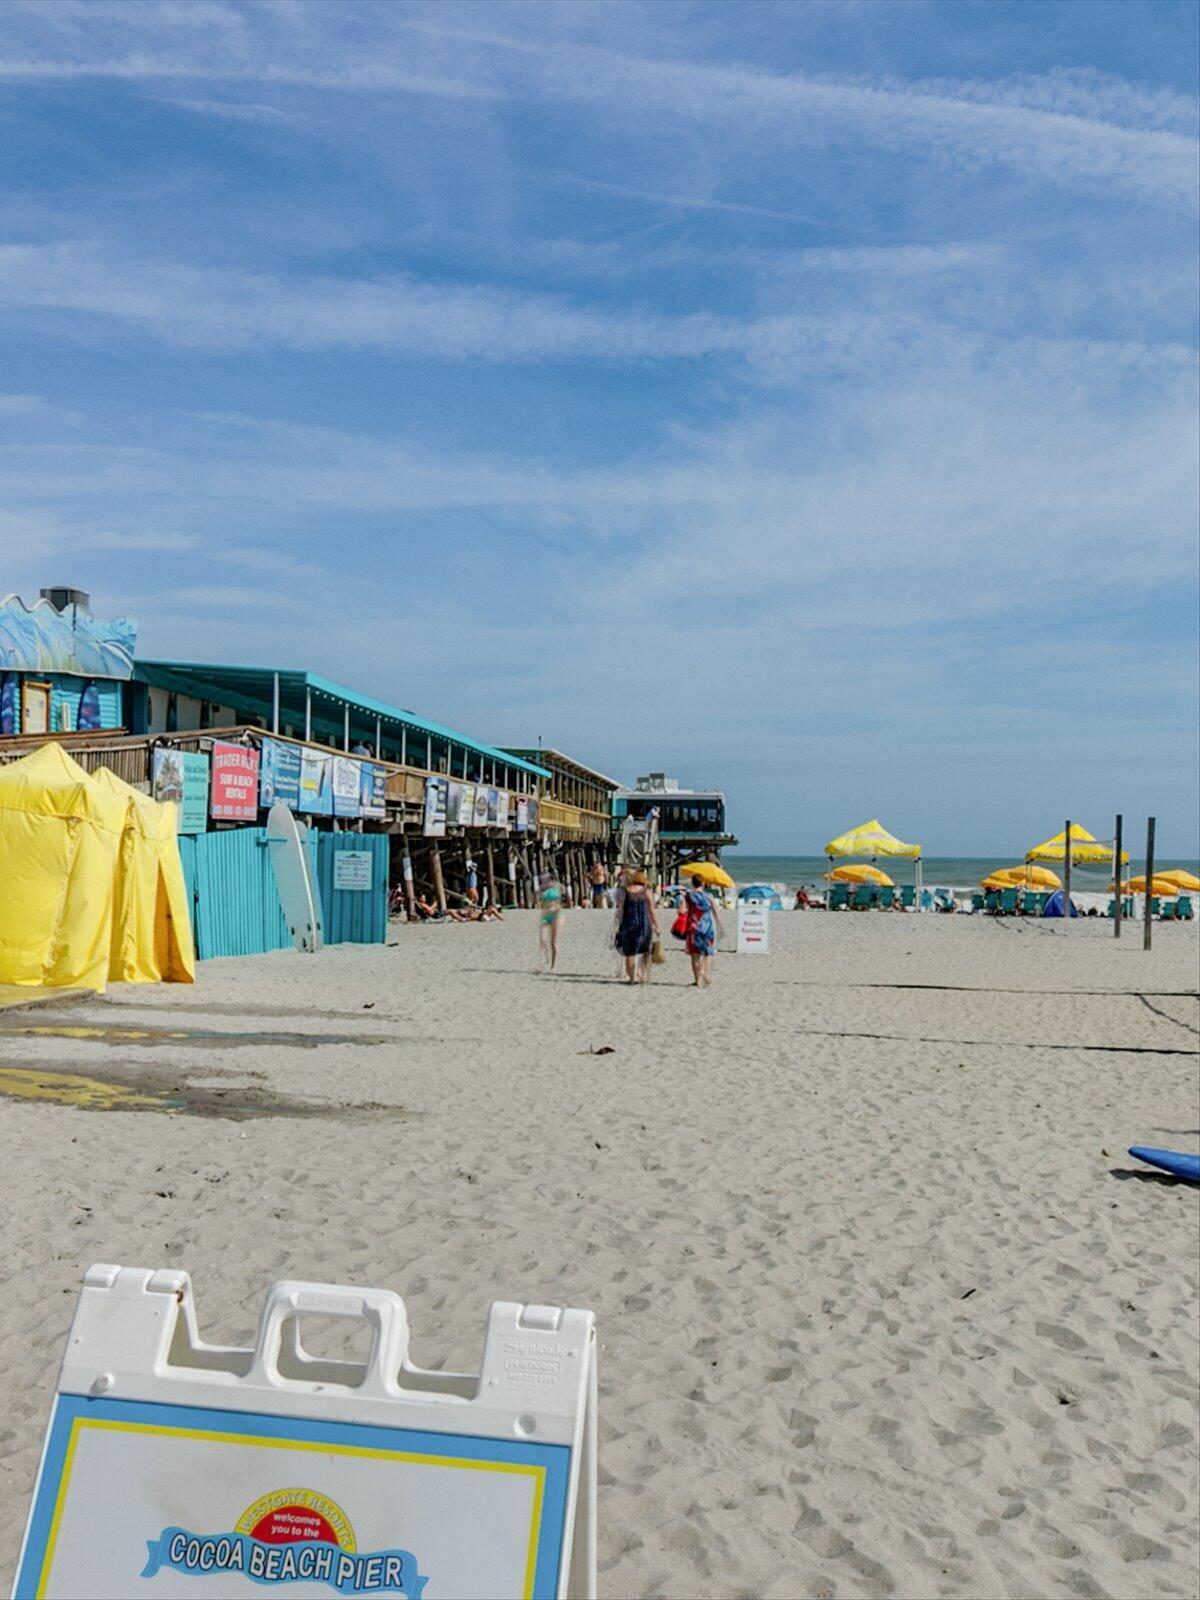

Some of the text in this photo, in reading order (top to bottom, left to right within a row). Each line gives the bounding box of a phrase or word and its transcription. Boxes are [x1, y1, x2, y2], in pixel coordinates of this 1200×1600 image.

[225, 787, 247, 800] RENTALS
[241, 1491, 353, 1548] WESTGATE RESORTS
[272, 1512, 321, 1527] welcomes
[271, 1524, 320, 1538] you to the
[169, 1533, 404, 1589] COCOA BEACH PIER
